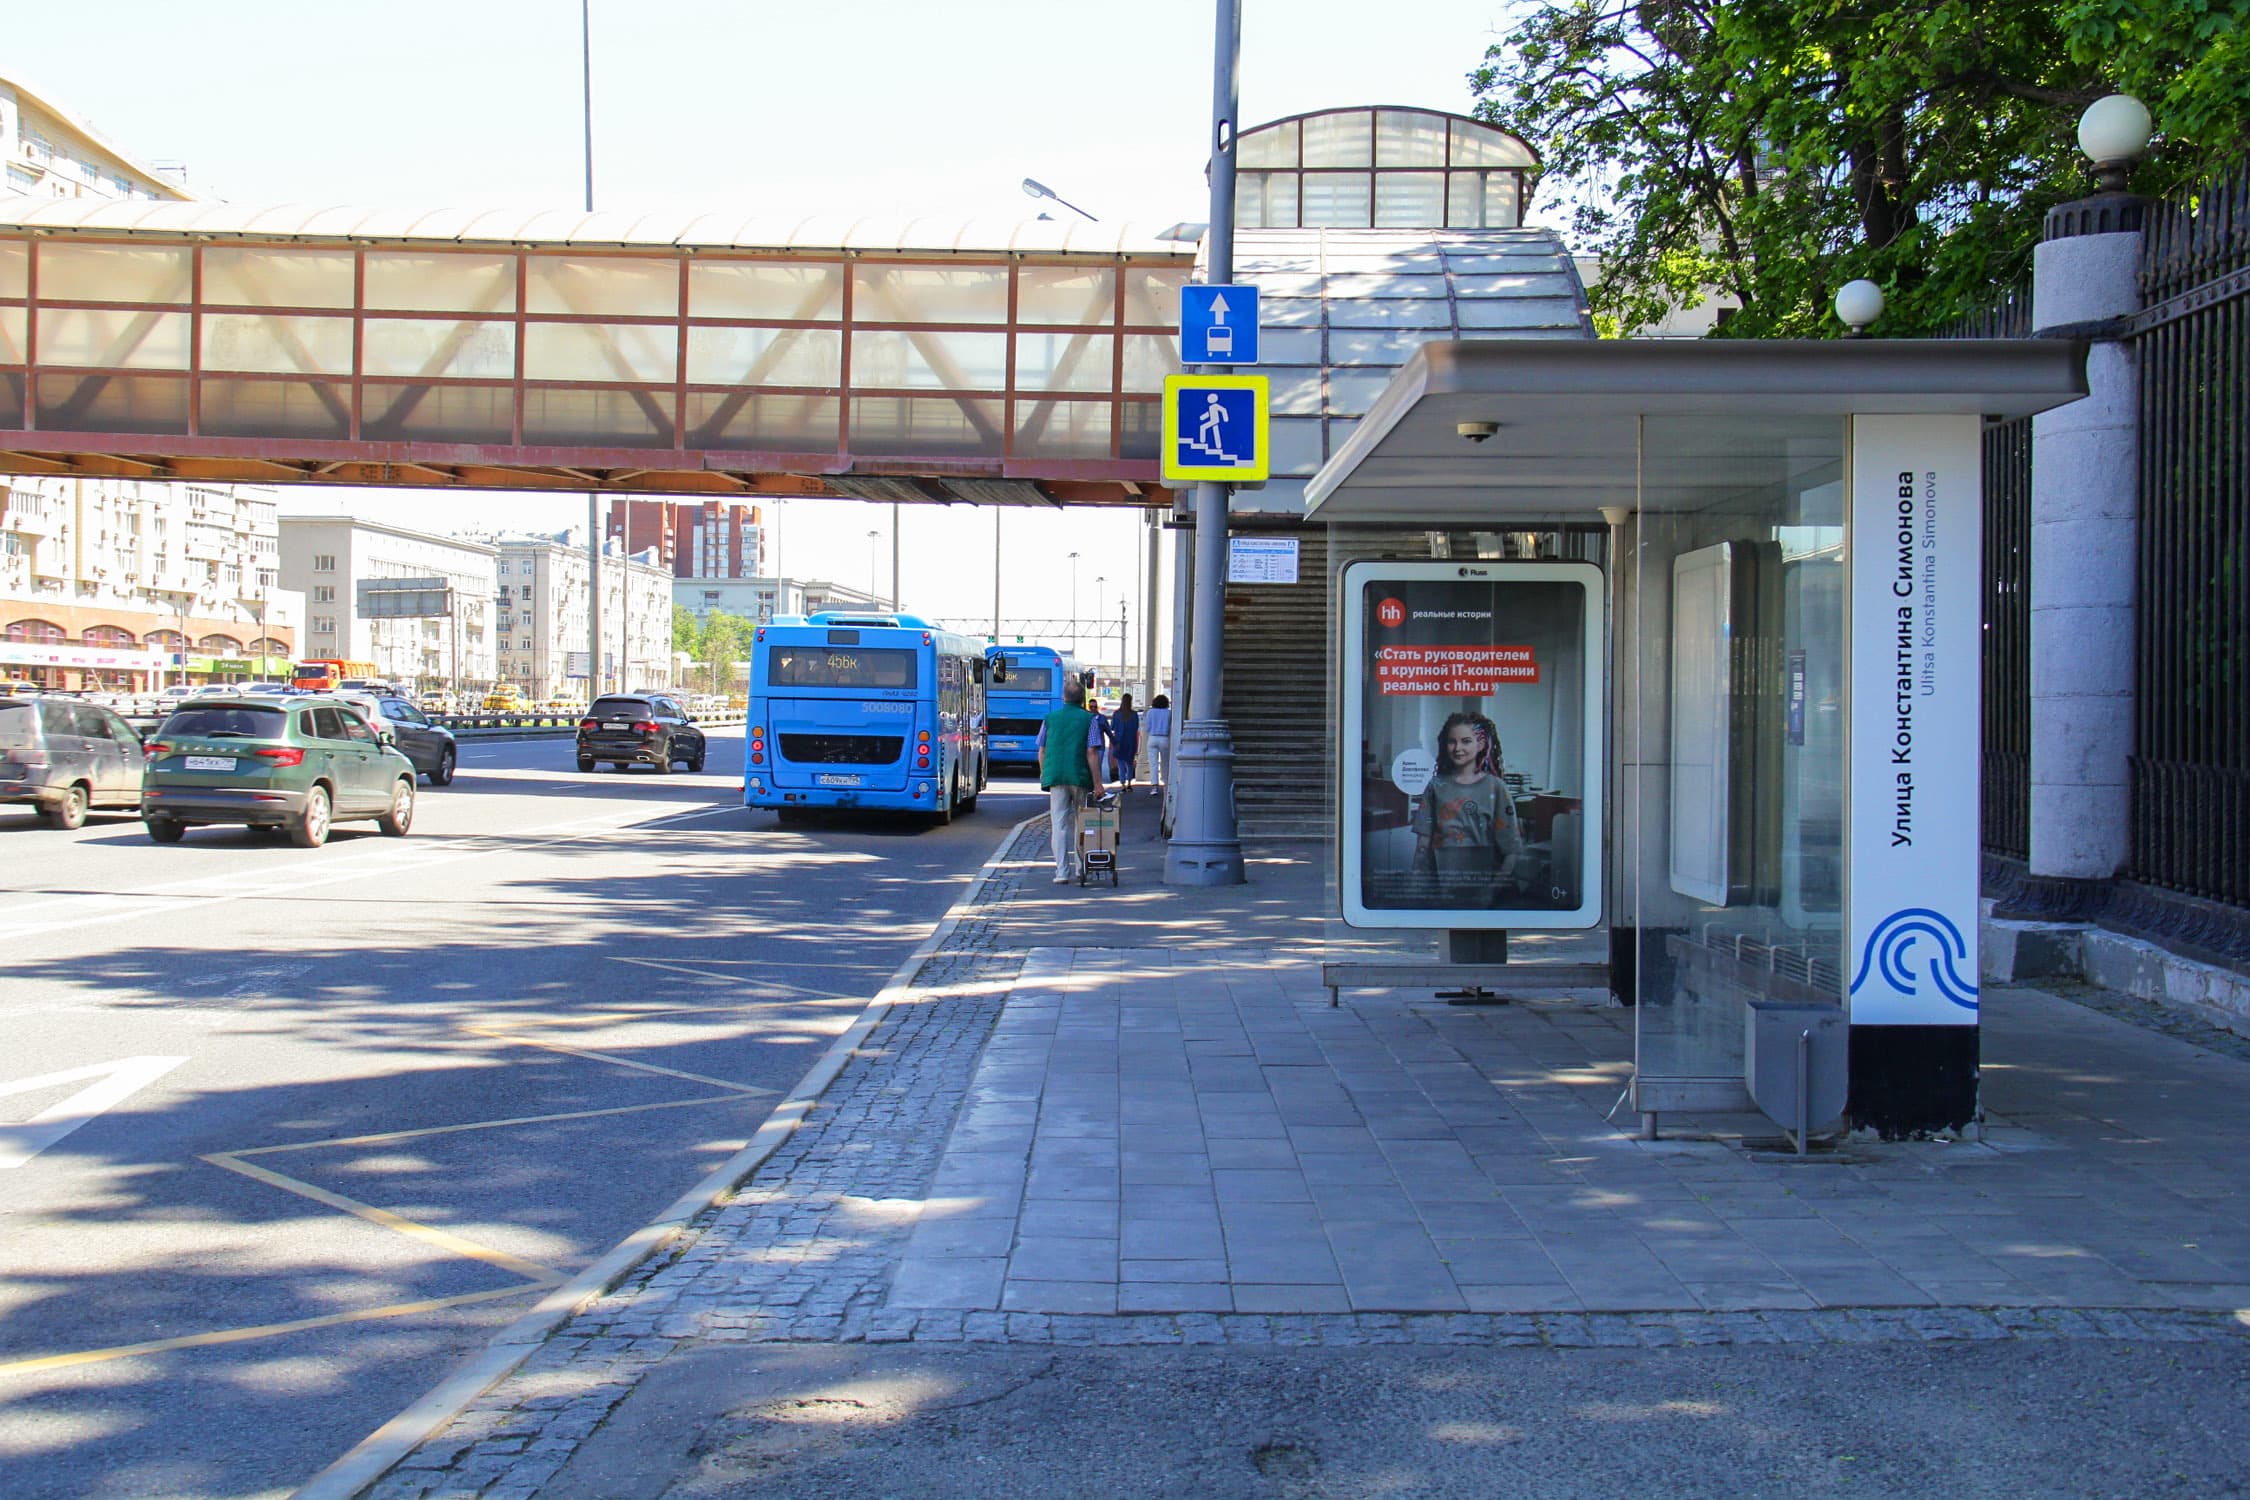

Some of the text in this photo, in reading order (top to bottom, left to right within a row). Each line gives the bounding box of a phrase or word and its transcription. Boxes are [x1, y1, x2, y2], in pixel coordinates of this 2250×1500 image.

[1920, 471, 1936, 696] Ulitsa Konstantina Simonova
[1381, 605, 1401, 620] hh
[1412, 610, 1492, 620] реальные истории
[1374, 648, 1530, 663] «Стать руководителем
[1891, 471, 1914, 847] Улица Константина Симонова
[1379, 664, 1535, 678] в крупной IT-компании
[1383, 681, 1440, 693] реально
[1443, 682, 1451, 692] с
